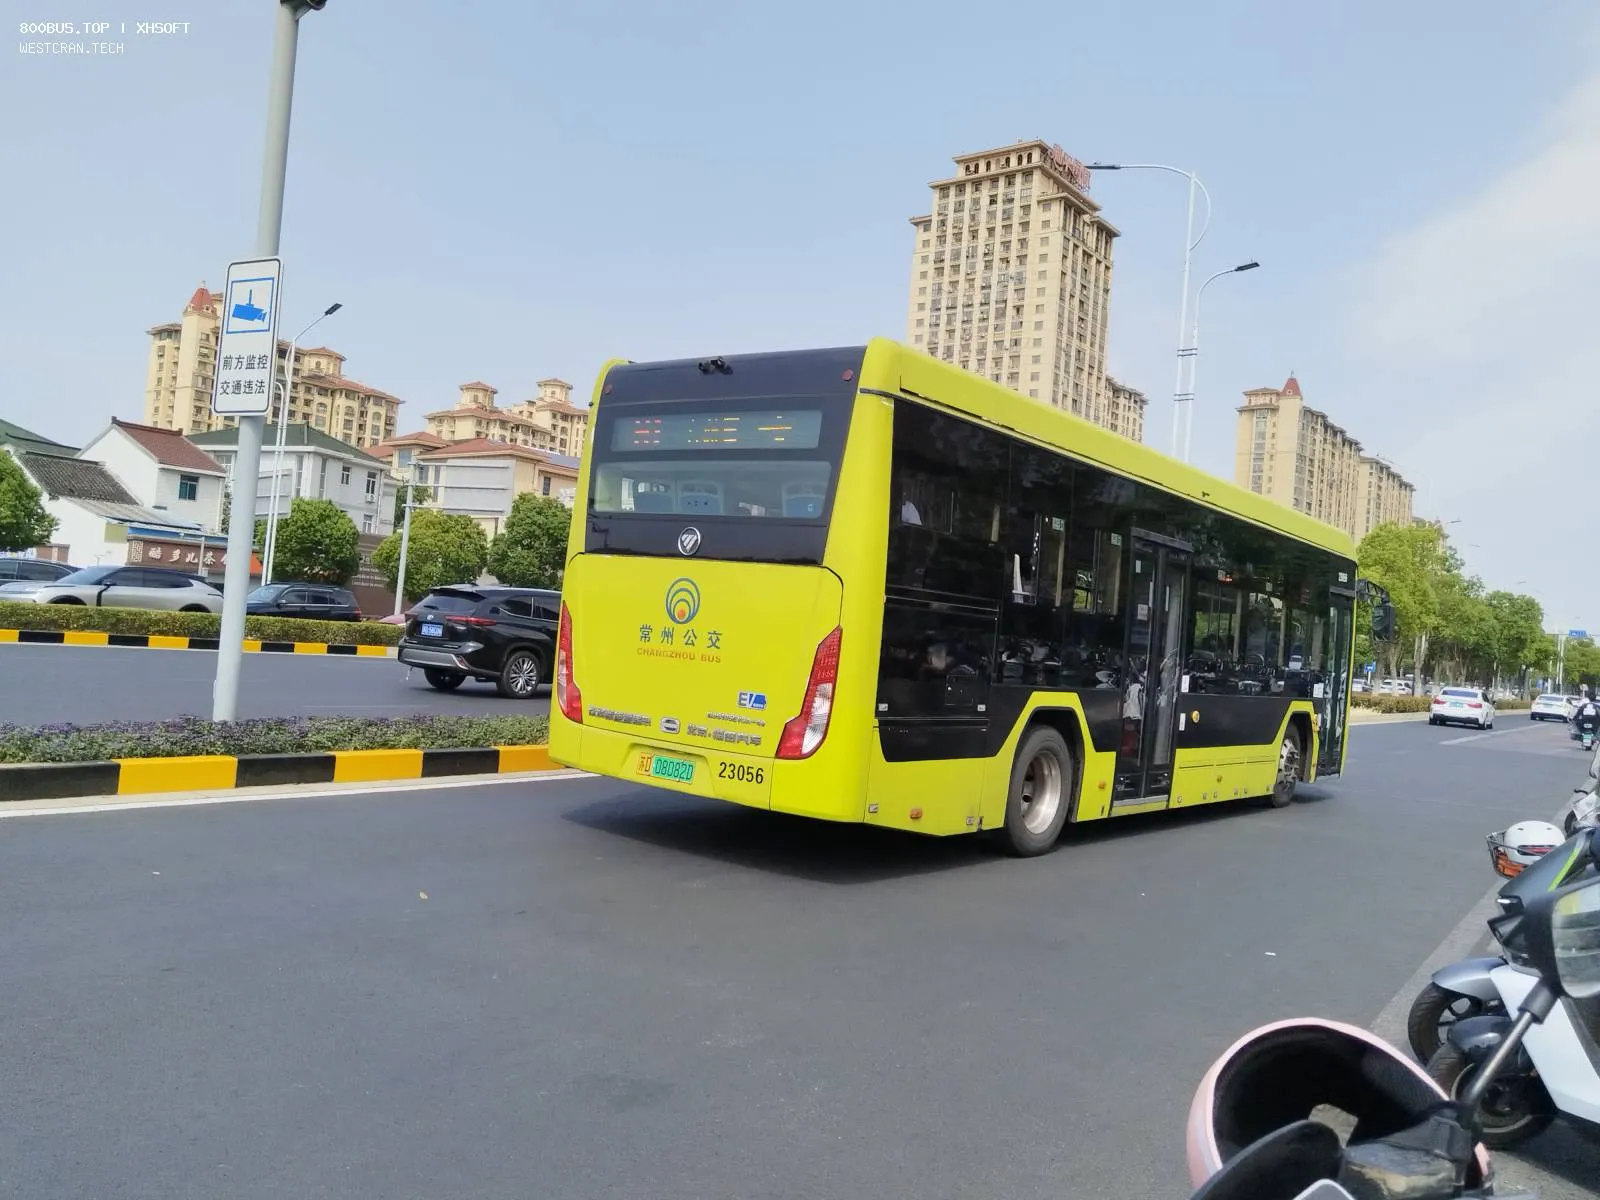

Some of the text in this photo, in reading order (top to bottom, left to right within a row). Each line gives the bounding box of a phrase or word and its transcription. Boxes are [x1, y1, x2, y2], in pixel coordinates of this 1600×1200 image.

[222, 353, 269, 371] 前方监控
[219, 379, 266, 396] 交通违法
[639, 623, 723, 650] 常州公交
[636, 647, 722, 664] CHANGZHOU BUS
[718, 761, 765, 785] 23056
